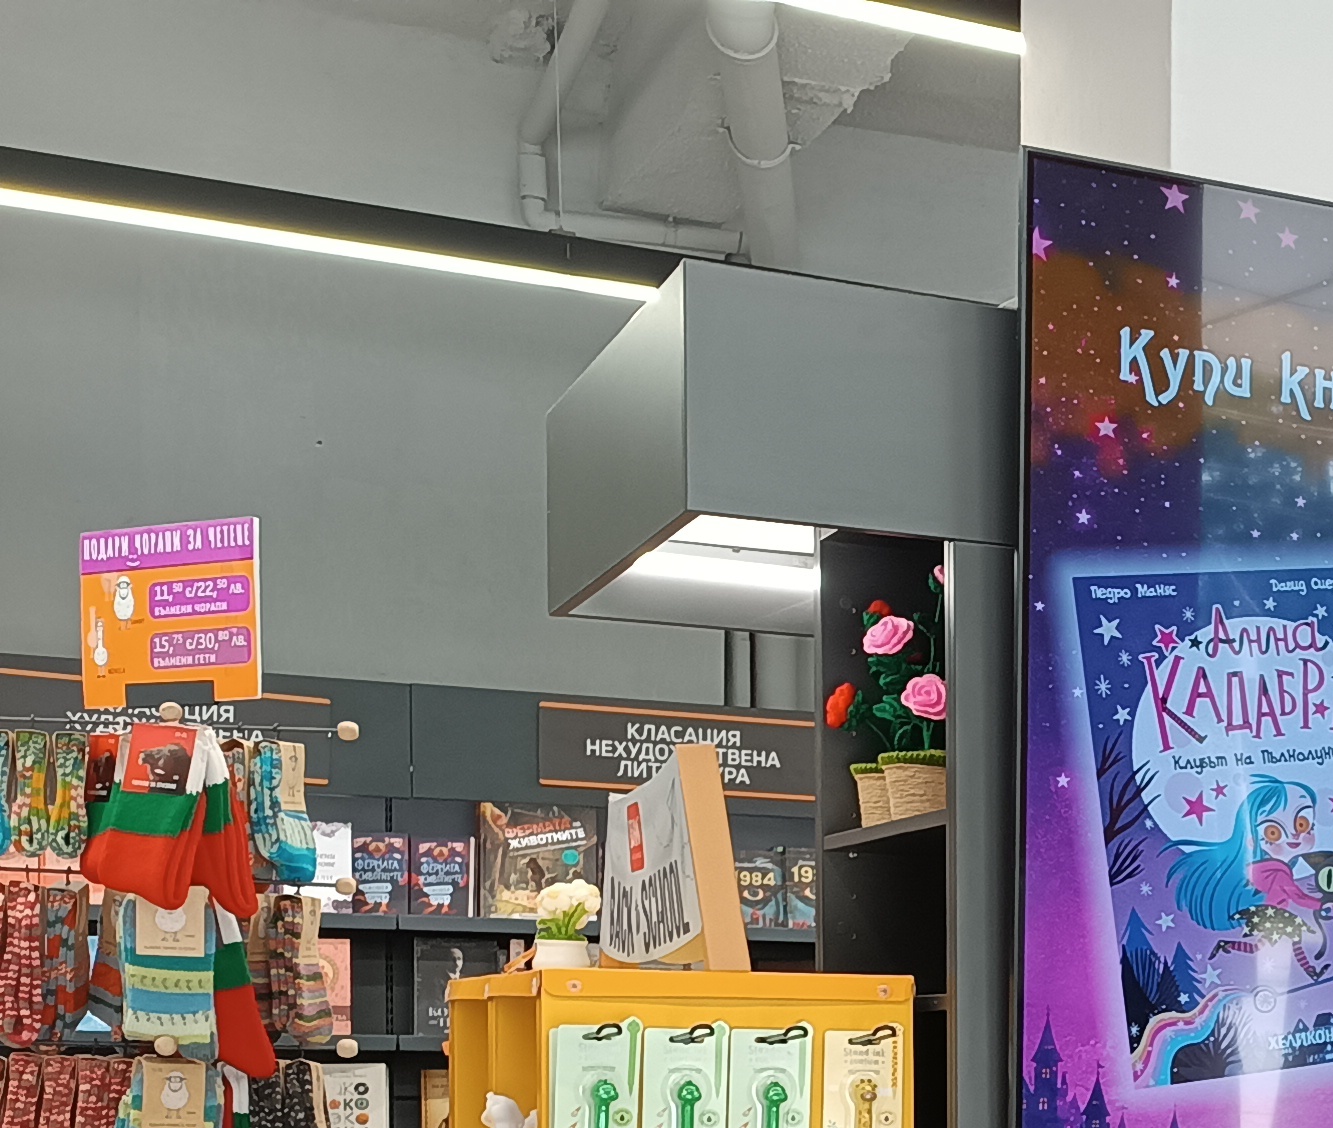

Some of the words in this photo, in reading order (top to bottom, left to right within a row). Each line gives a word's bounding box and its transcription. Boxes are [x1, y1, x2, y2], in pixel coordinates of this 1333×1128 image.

[1119, 327, 1252, 407] Купи
[83, 536, 128, 560] ПОДАРИ
[135, 530, 181, 555] ЧОРАПИ
[187, 528, 201, 550] ЗА
[208, 523, 249, 548] ЧЕТЕНЕ
[1090, 585, 1131, 602] Педро
[1270, 579, 1306, 594] Давид
[194, 602, 227, 613] ЧОРАПИ
[1205, 604, 1329, 658] Анна
[627, 723, 740, 746] КЛАСАЦИЯ
[586, 739, 780, 768] НЕХУДОТВЕНА
[1173, 754, 1227, 773] Клубът
[1234, 753, 1254, 766] на
[609, 876, 635, 957] BACK
[641, 860, 690, 954] SCHOOL
